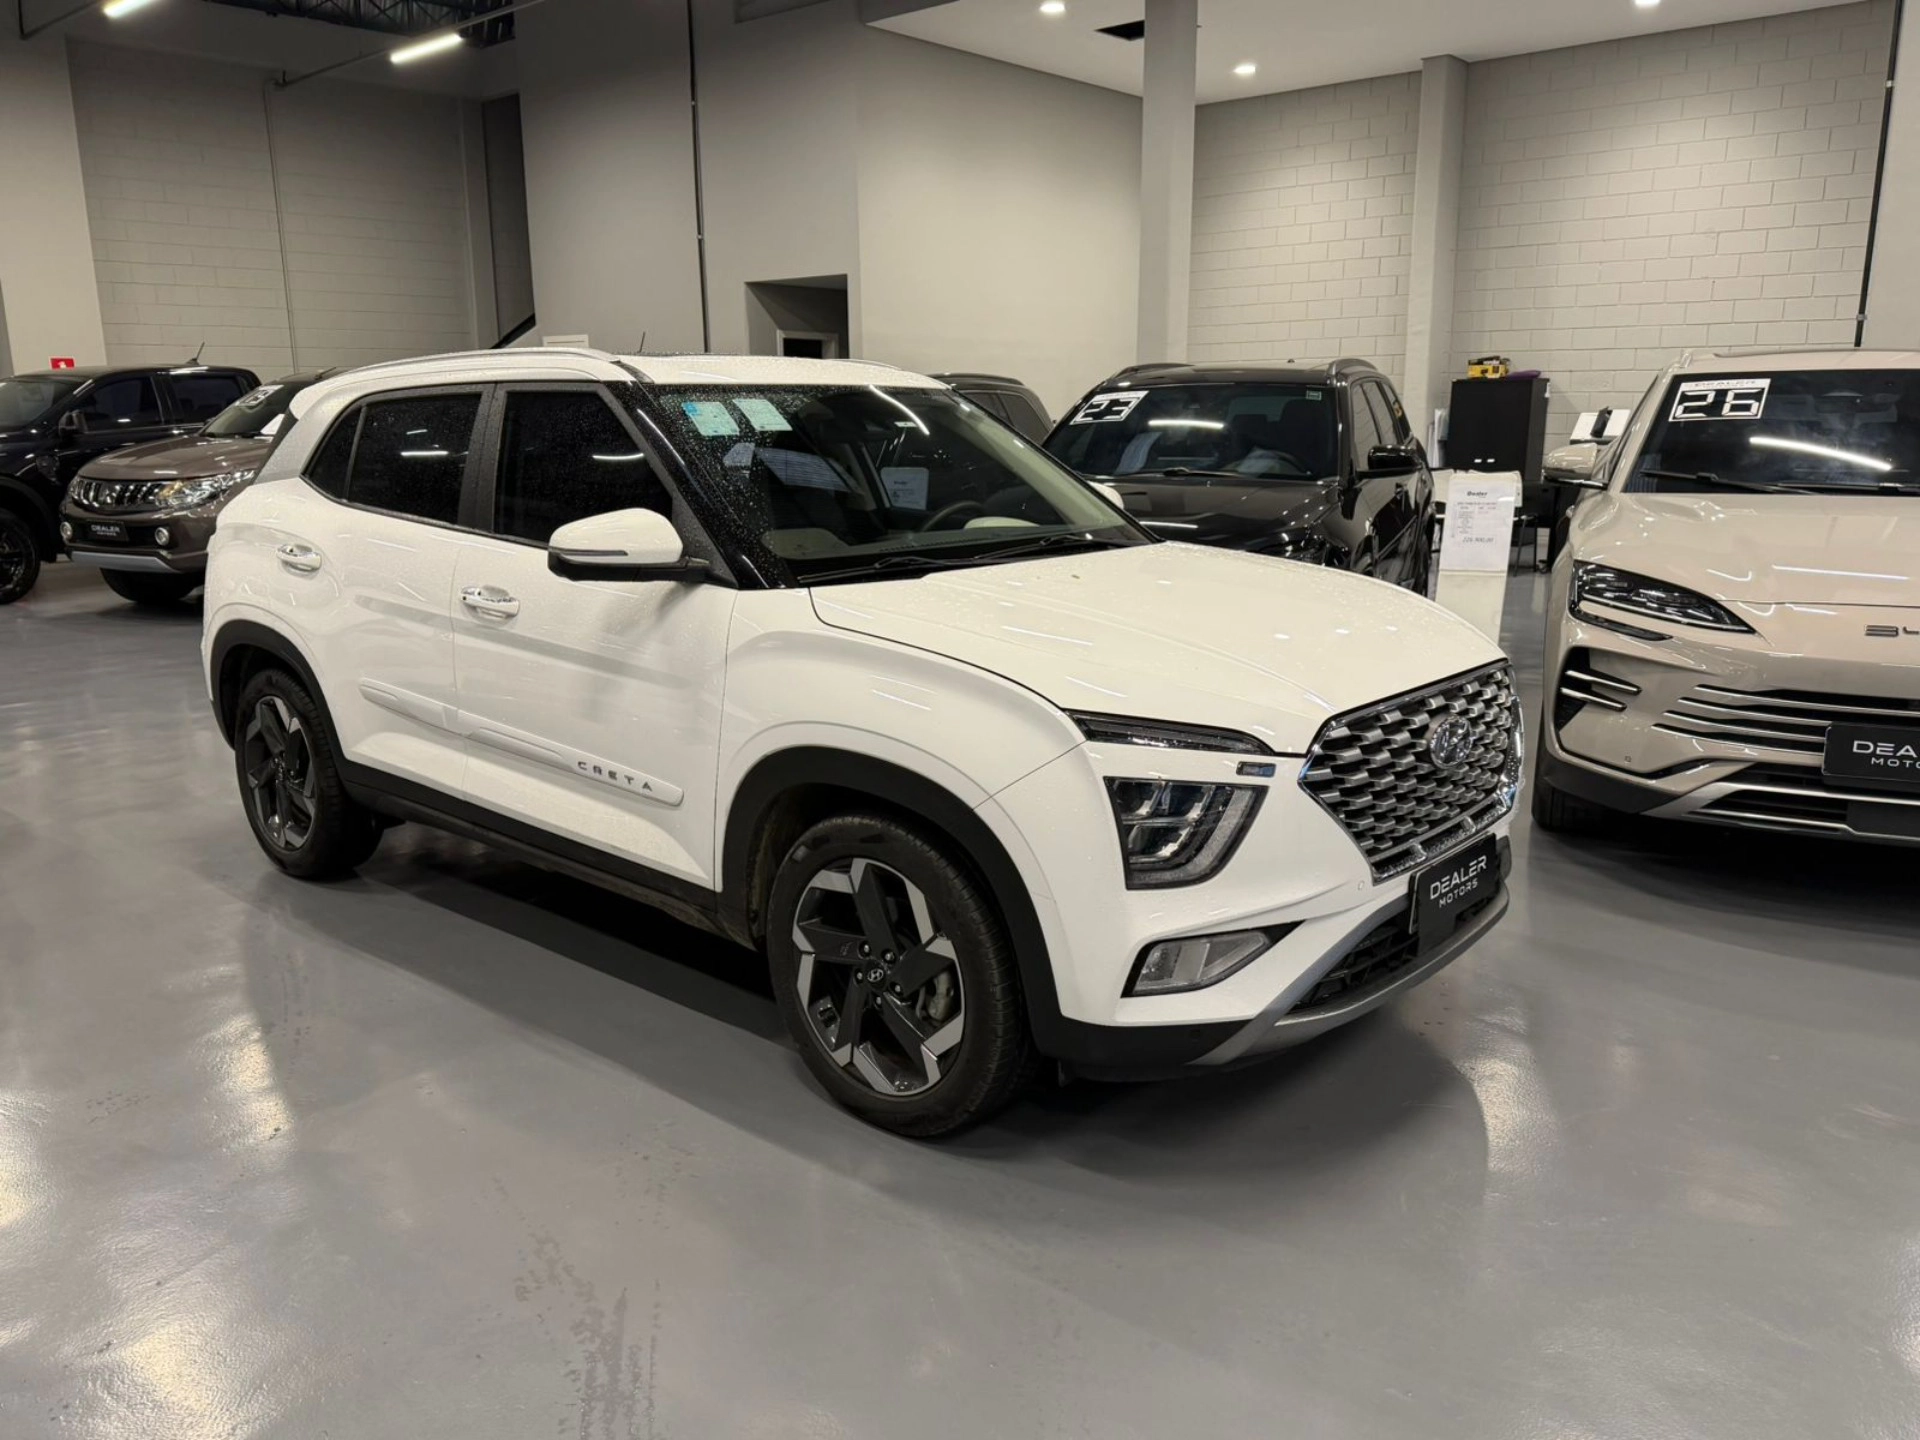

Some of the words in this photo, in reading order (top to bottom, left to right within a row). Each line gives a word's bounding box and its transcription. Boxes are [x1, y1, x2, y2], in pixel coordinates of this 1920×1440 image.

[1077, 397, 1139, 421] 23
[1674, 388, 1763, 419] 26
[577, 761, 653, 792] CRETA
[1430, 855, 1488, 900] DEALER
[1439, 877, 1478, 908] MOTORS
